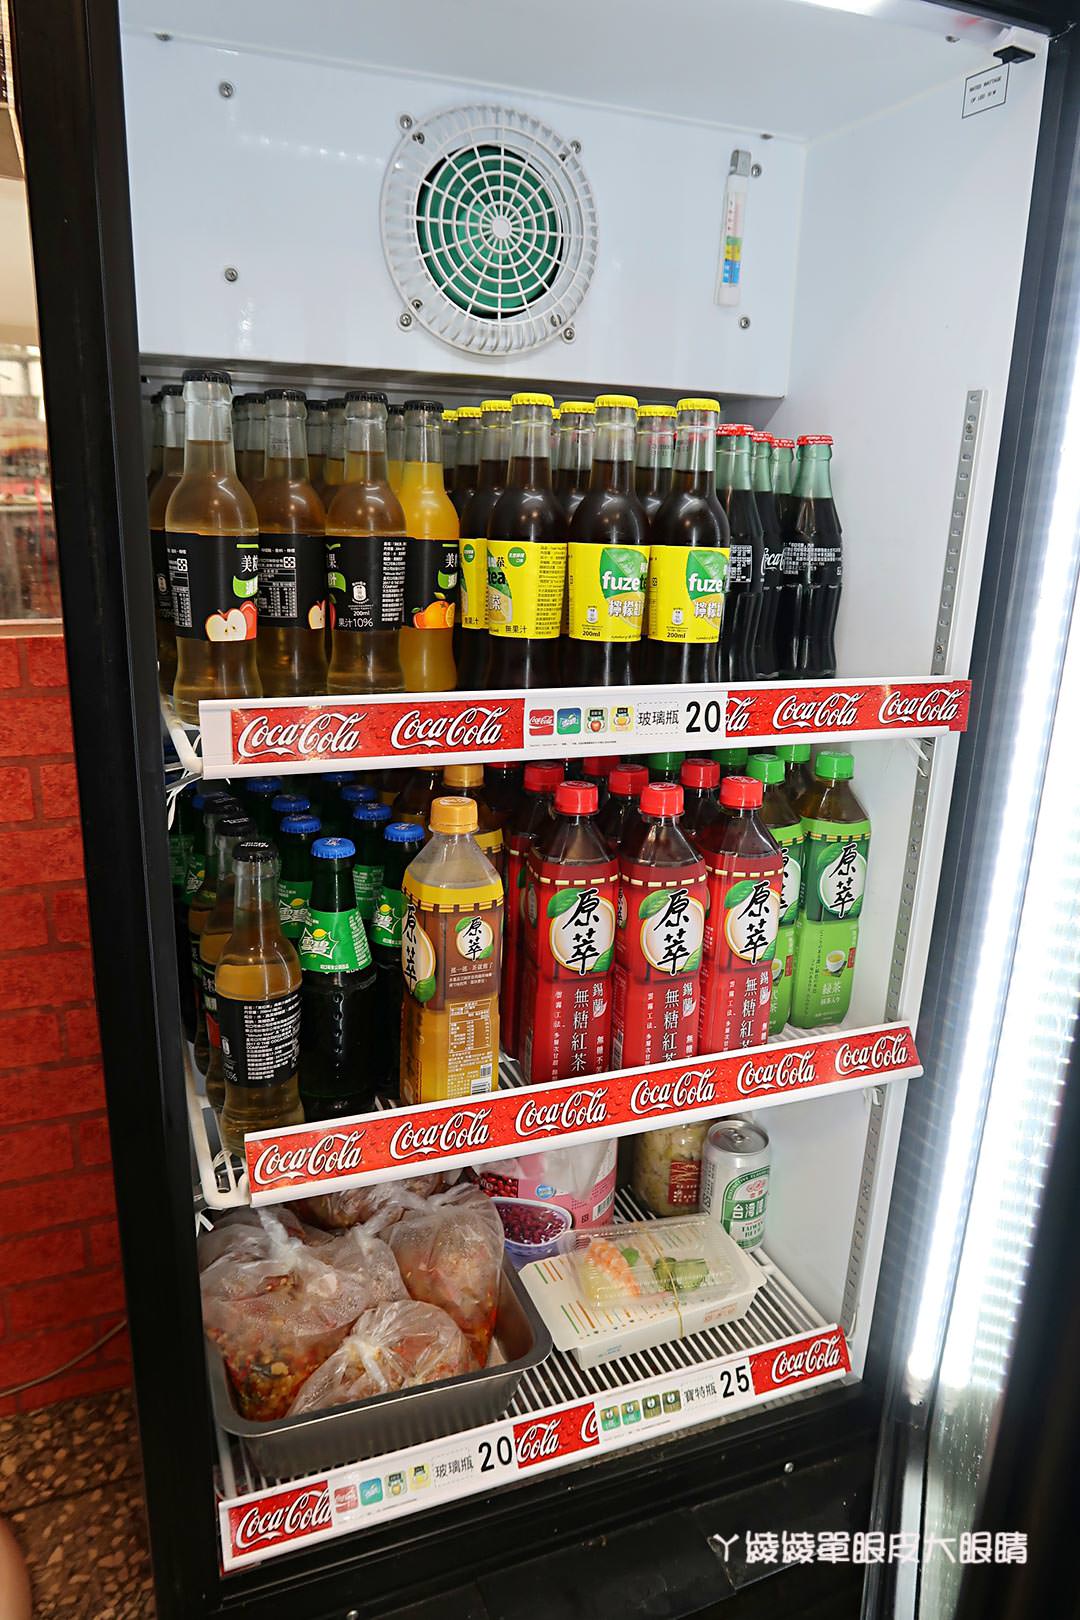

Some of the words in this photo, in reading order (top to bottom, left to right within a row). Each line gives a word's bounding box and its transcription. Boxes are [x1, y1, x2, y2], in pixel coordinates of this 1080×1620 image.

[505, 625, 528, 634] 無果汁
[638, 710, 680, 727] 玻璃瓶
[686, 700, 720, 733] 20
[828, 842, 860, 918] 原萃
[463, 916, 482, 962] 原萃
[562, 888, 600, 976] 原萃
[653, 888, 690, 976] 原萃
[737, 880, 771, 965] 原萃
[571, 988, 590, 1072] 無糖紅茶
[720, 1364, 750, 1398] 25
[434, 1455, 474, 1478] 玻璃瓶
[478, 1436, 513, 1473] 20
